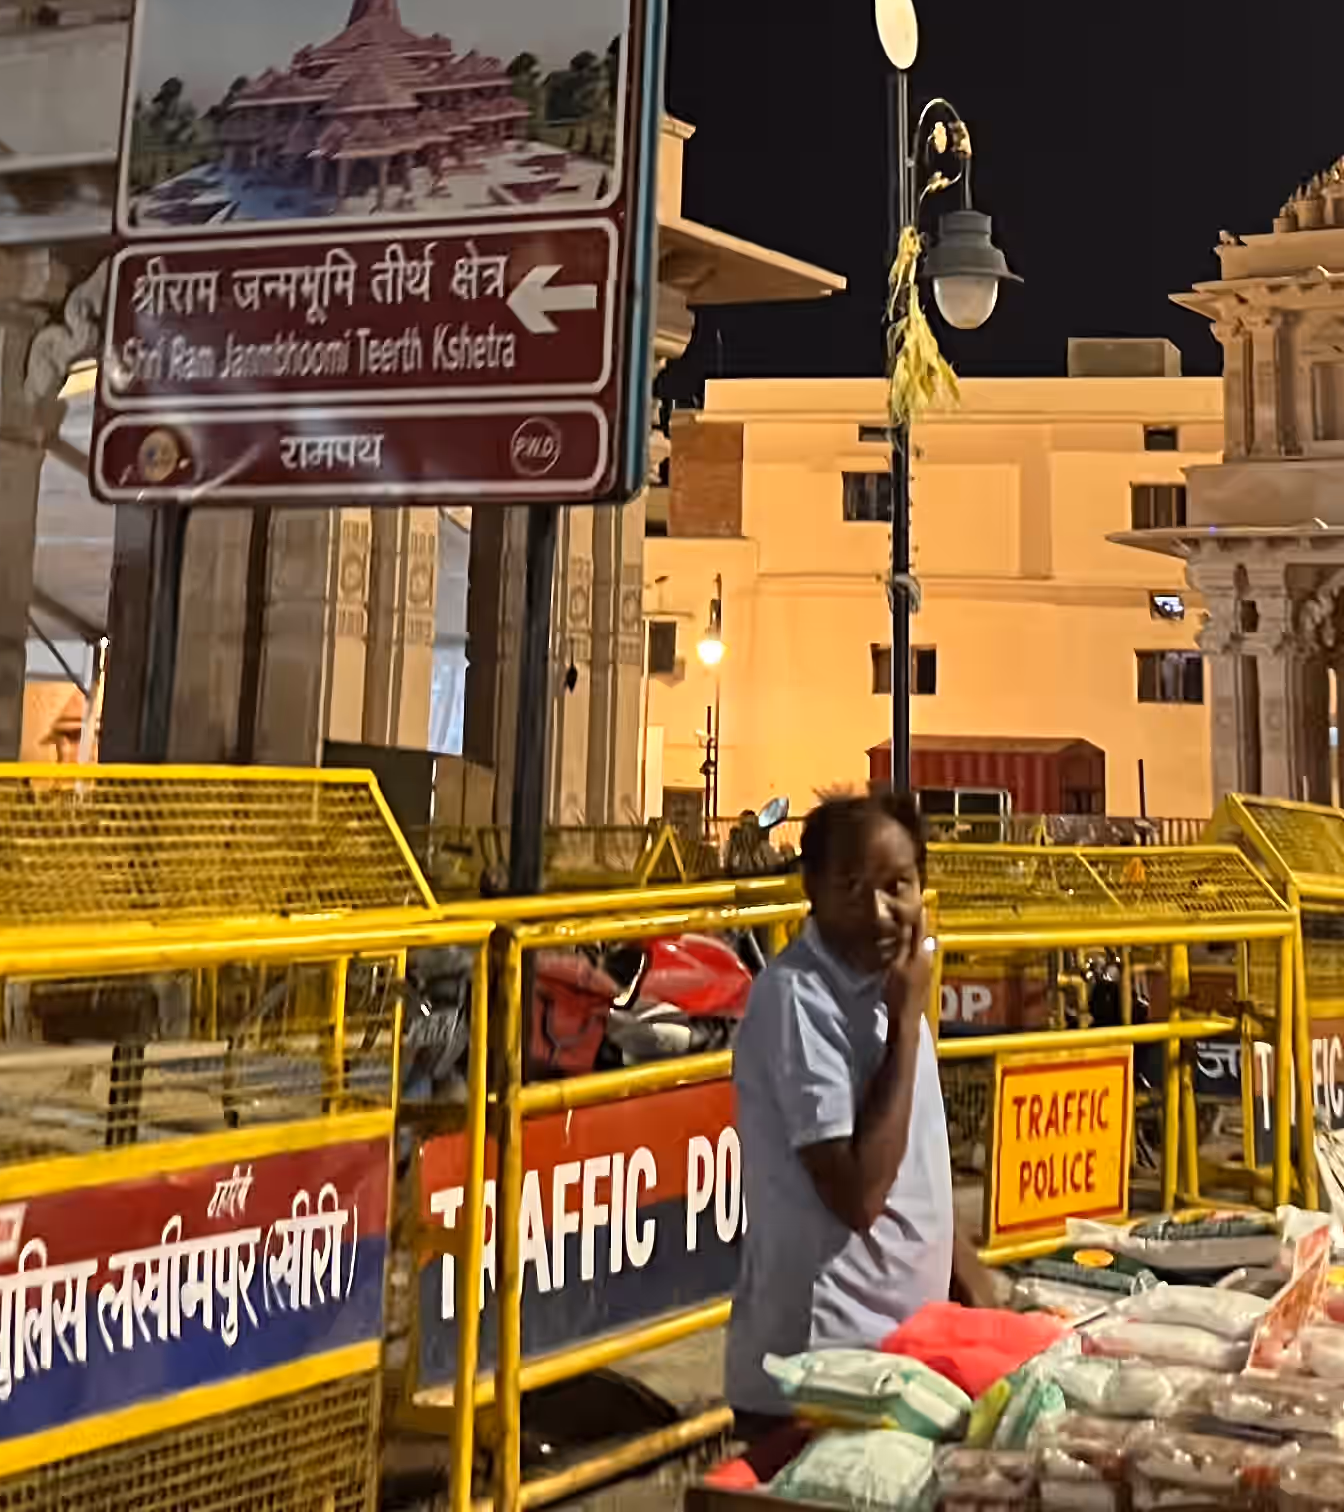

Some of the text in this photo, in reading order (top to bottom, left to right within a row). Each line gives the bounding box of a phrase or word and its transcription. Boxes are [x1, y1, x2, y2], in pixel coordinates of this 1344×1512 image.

[131, 239, 509, 325] श्रीराम जन्मभूमि तीर्थ क्षेत्र
[168, 336, 215, 381] Ram
[357, 325, 422, 376] Teerth
[432, 323, 516, 371] Kshetra
[279, 432, 385, 470] रामपथ
[1012, 1086, 1109, 1141] TRAFFIC
[686, 1125, 748, 1252] PO
[1019, 1149, 1097, 1203] POLICE
[97, 1215, 262, 1358] लखीमपुर
